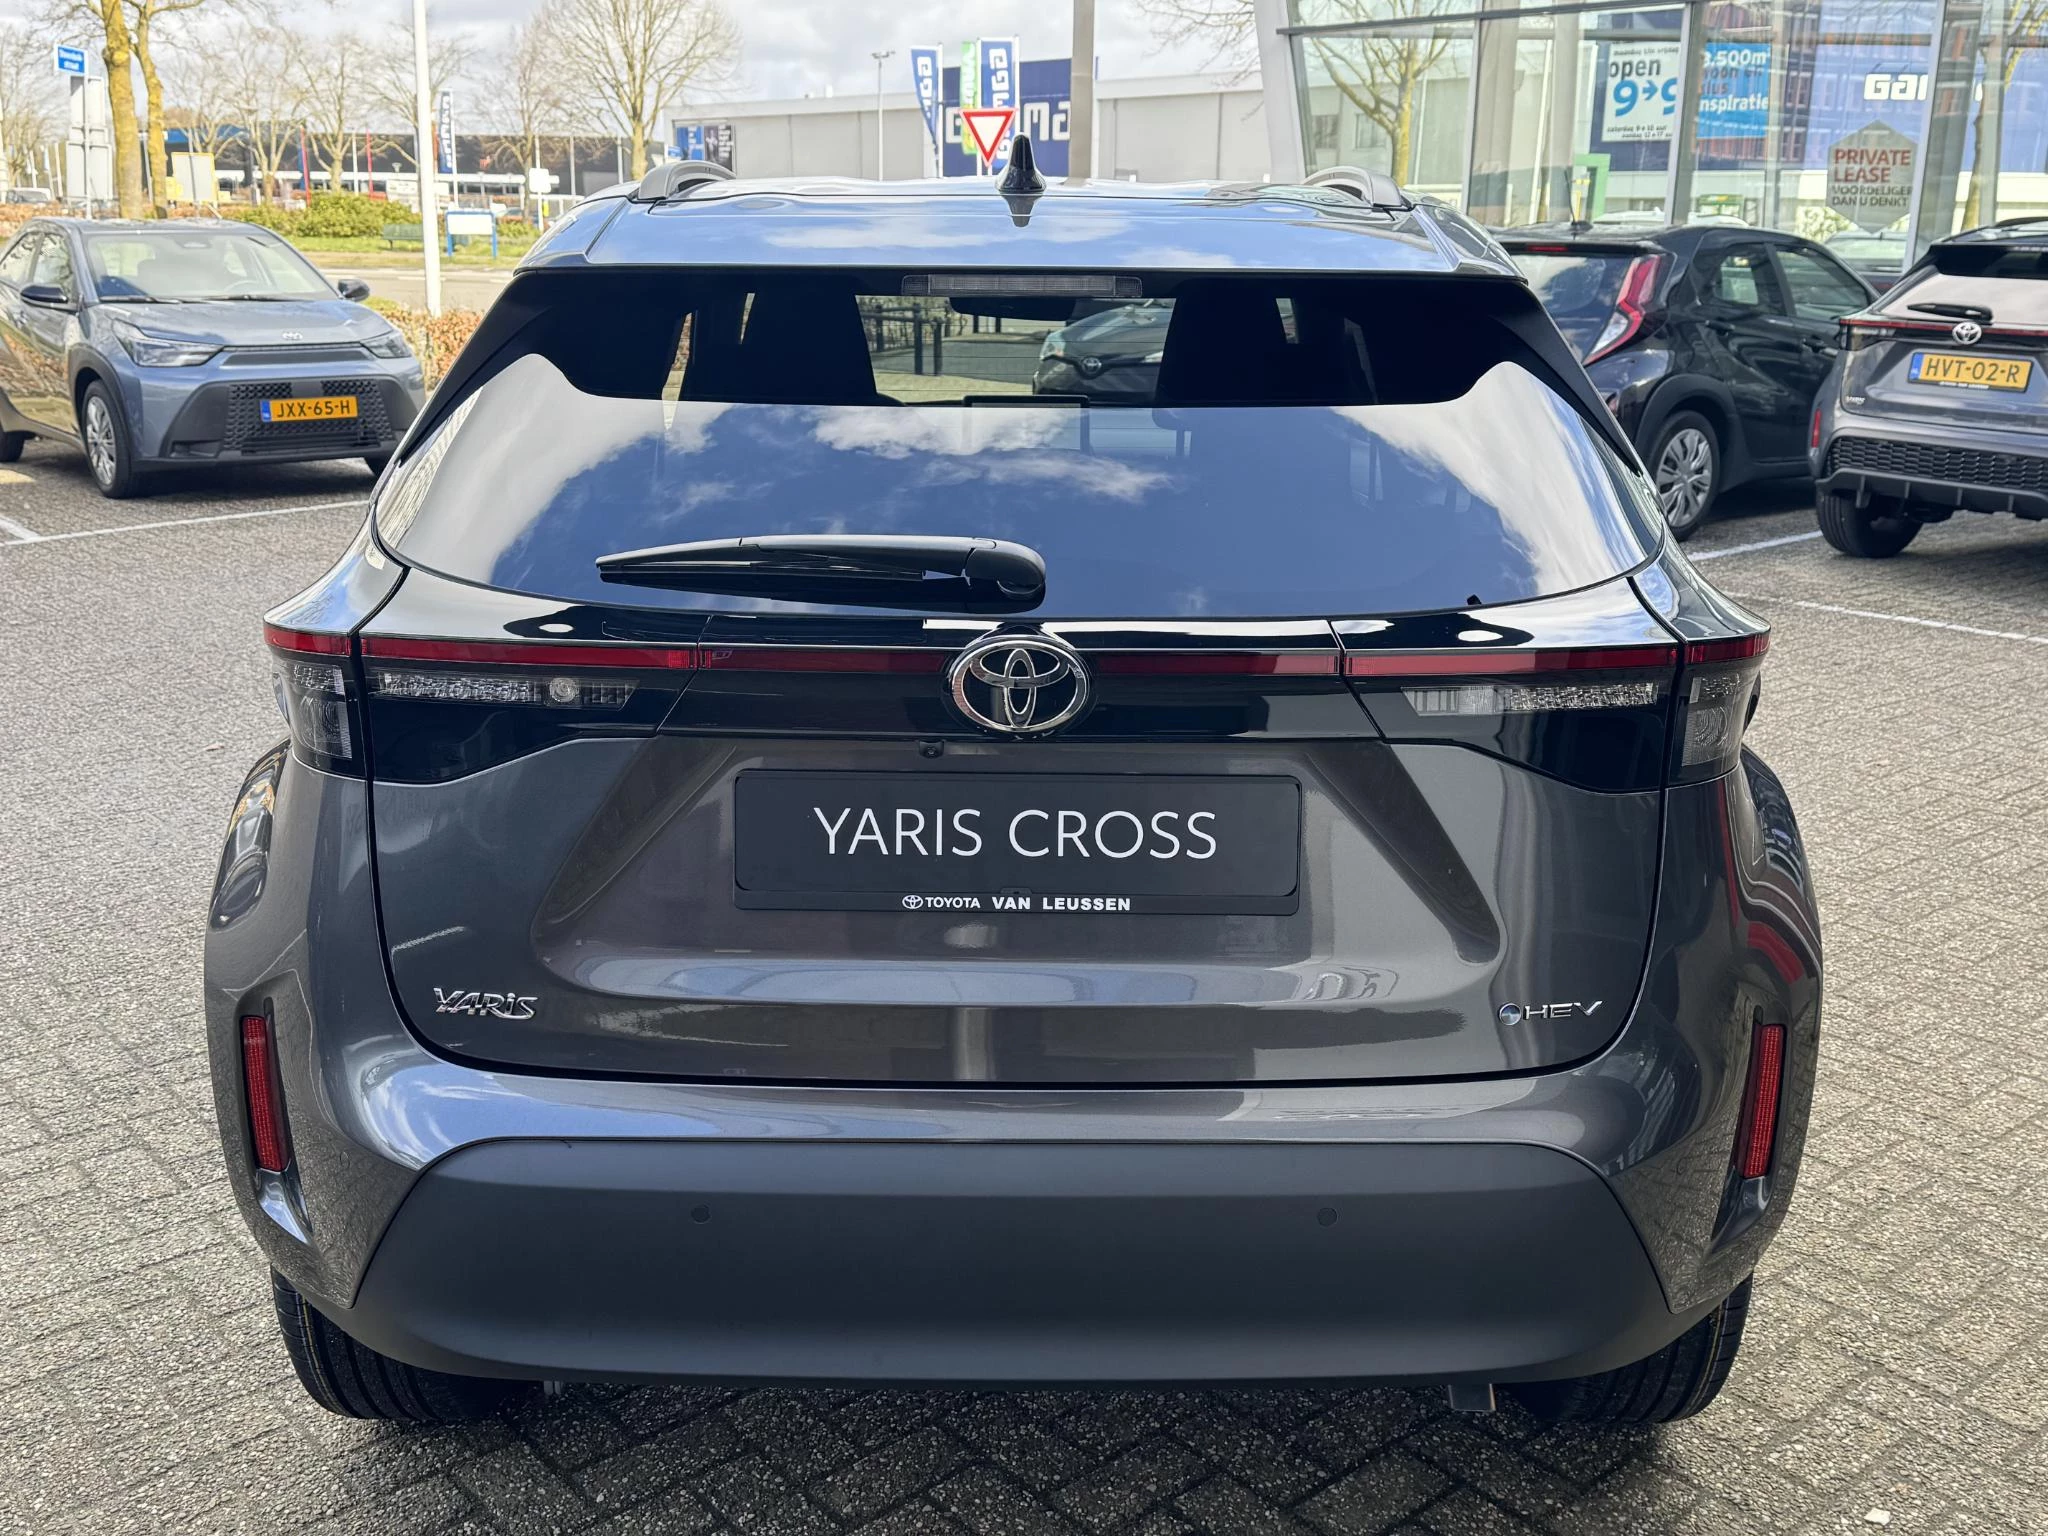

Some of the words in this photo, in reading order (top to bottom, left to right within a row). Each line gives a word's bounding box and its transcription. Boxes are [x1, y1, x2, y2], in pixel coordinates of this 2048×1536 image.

[1609, 59, 1661, 81] open
[1703, 66, 1738, 79] oon
[1613, 80, 1639, 117] 9
[1699, 92, 1769, 114] nspiratie
[1835, 148, 1911, 165] PRIVATE
[1834, 167, 1891, 182] LEASE
[1832, 196, 1857, 206] DAN
[1860, 197, 1868, 206] U
[1869, 197, 1908, 207] DENKT
[1926, 357, 2020, 384] HVT-02-R
[277, 400, 350, 418] JXX-65-H
[813, 807, 983, 857] YARIS
[1008, 809, 1217, 860] CROSS
[924, 896, 981, 909] TOYOTA
[991, 896, 1031, 910] VAN
[1042, 896, 1131, 911] LEUSSEN
[1525, 1000, 1603, 1020] HEV
